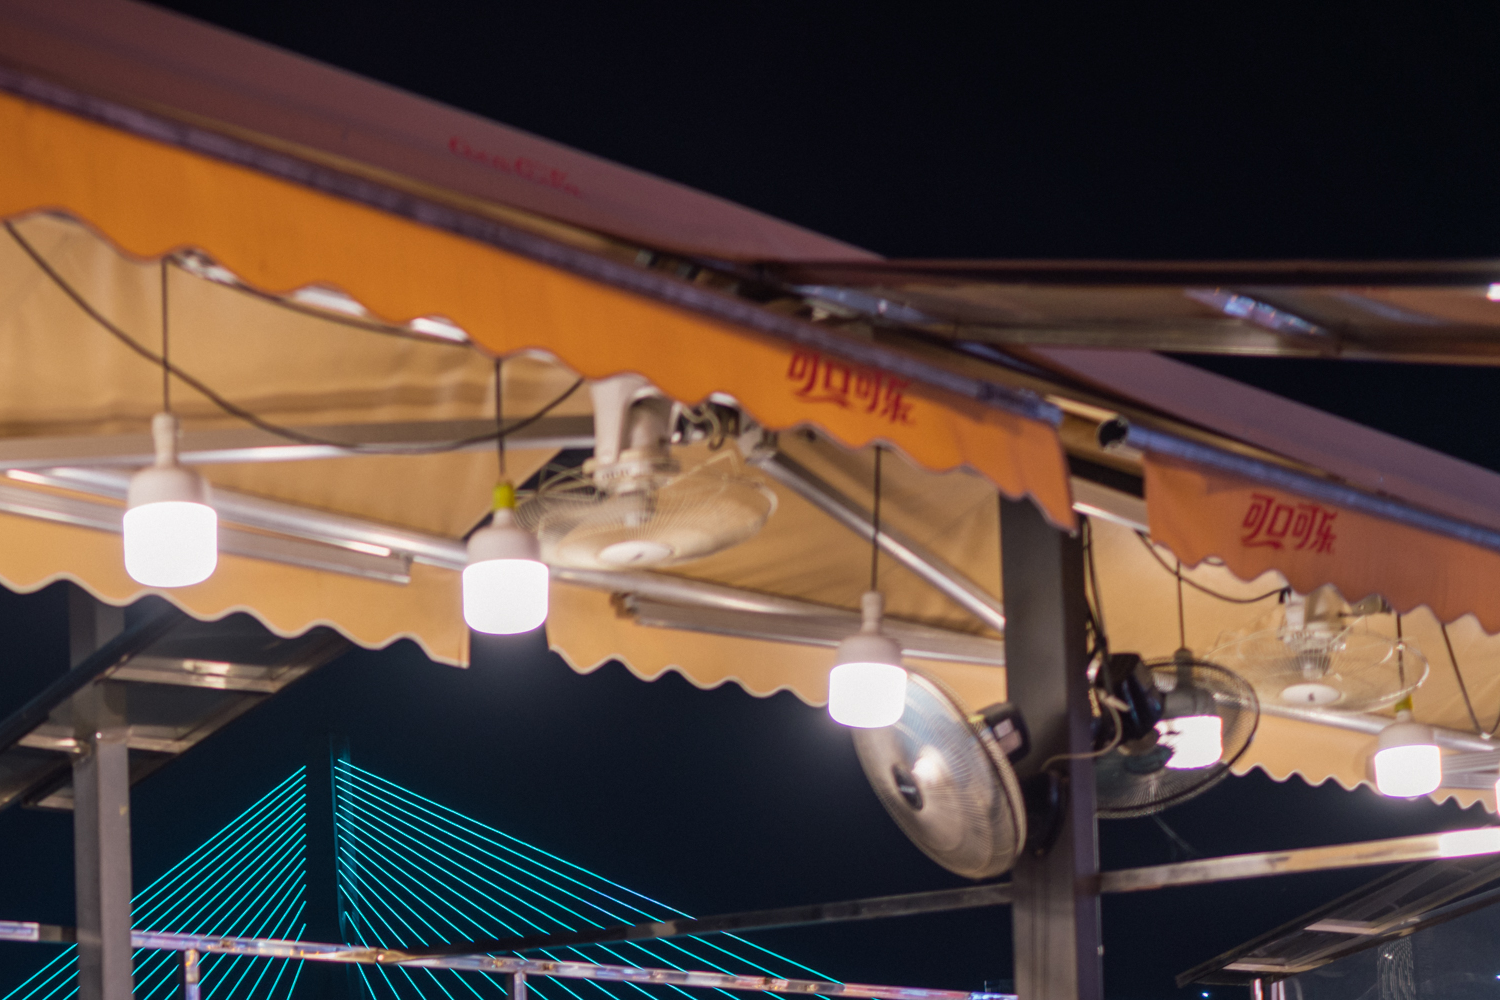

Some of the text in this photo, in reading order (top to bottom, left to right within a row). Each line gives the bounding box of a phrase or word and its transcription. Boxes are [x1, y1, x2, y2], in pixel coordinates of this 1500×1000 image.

[786, 348, 916, 425] 可口可乐
[1241, 493, 1337, 553] 可口可乐
